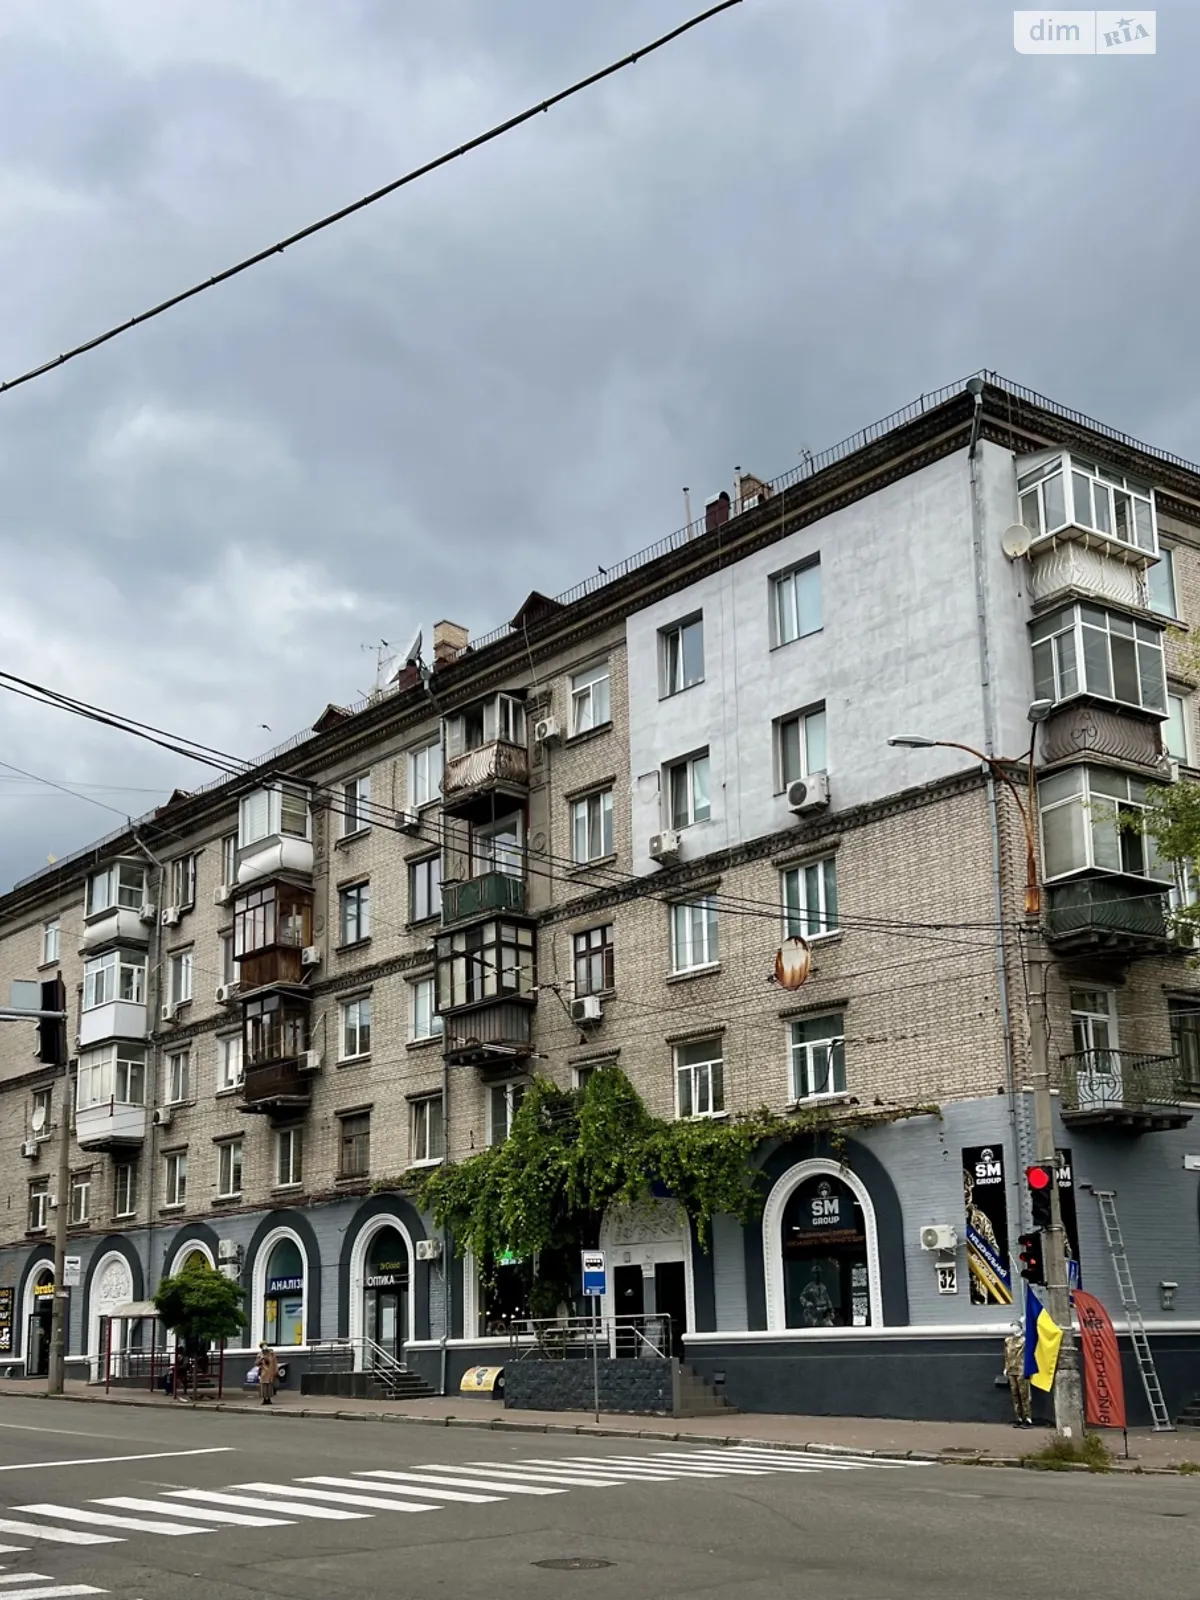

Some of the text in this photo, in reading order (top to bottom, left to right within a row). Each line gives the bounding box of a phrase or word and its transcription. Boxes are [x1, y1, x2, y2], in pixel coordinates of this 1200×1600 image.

[975, 1162, 1002, 1178] SM
[976, 1177, 1002, 1186] GROUP
[811, 1198, 840, 1216] SM
[812, 1215, 841, 1226] GROUP
[367, 1274, 395, 1287] ОПТИКА
[940, 1269, 955, 1289] 32
